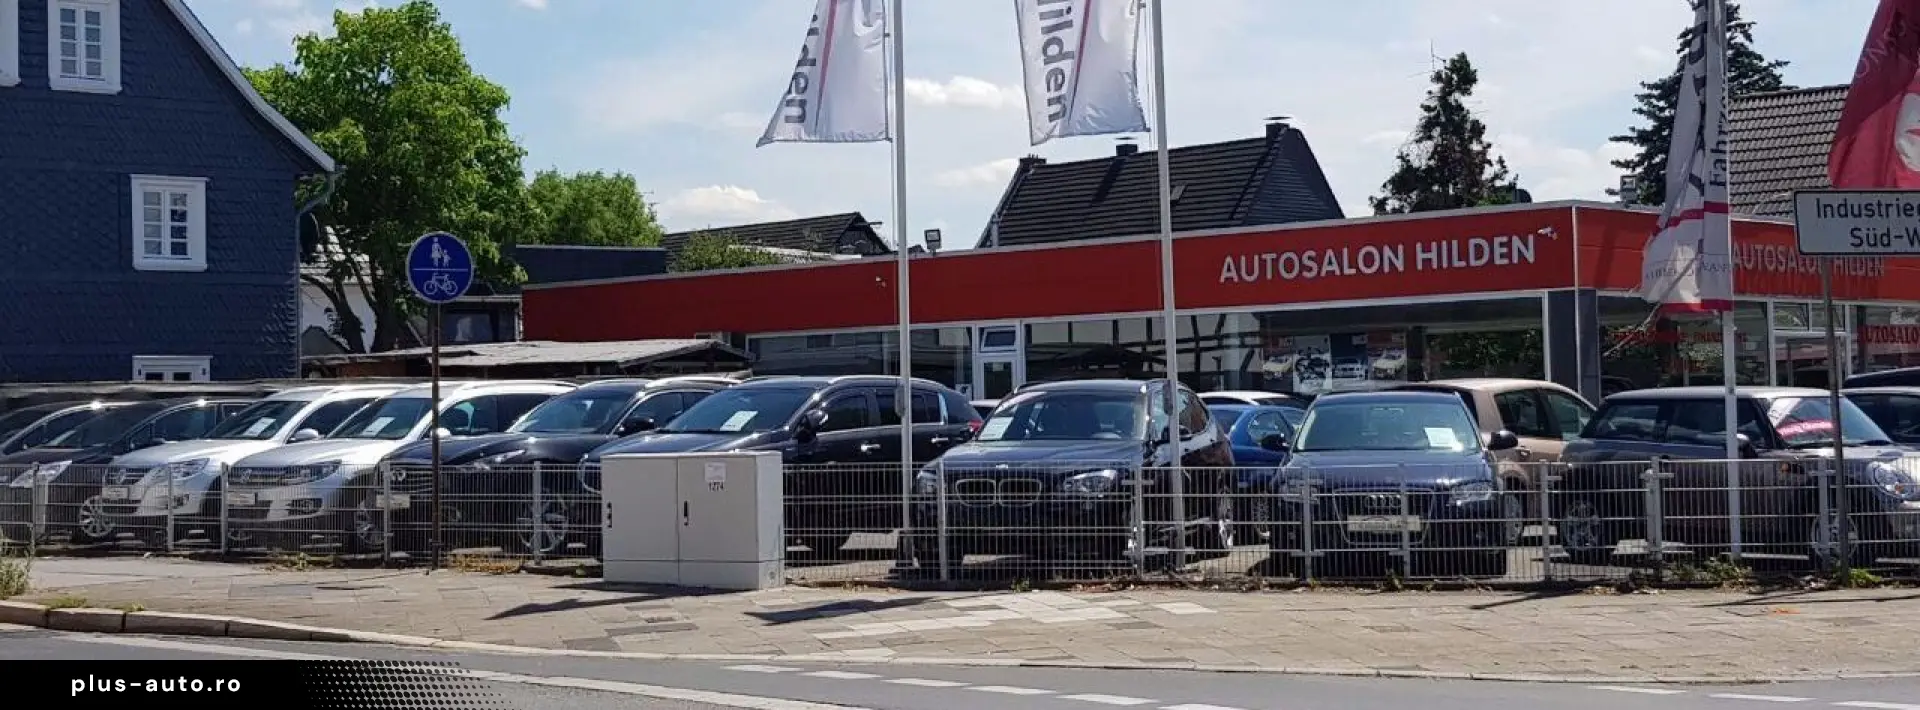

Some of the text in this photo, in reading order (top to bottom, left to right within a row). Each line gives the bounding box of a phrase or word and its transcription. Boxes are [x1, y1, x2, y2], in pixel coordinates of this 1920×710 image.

[1815, 198, 1920, 220] Industrie
[1219, 234, 1535, 283] AUTOSALON HILDEN
